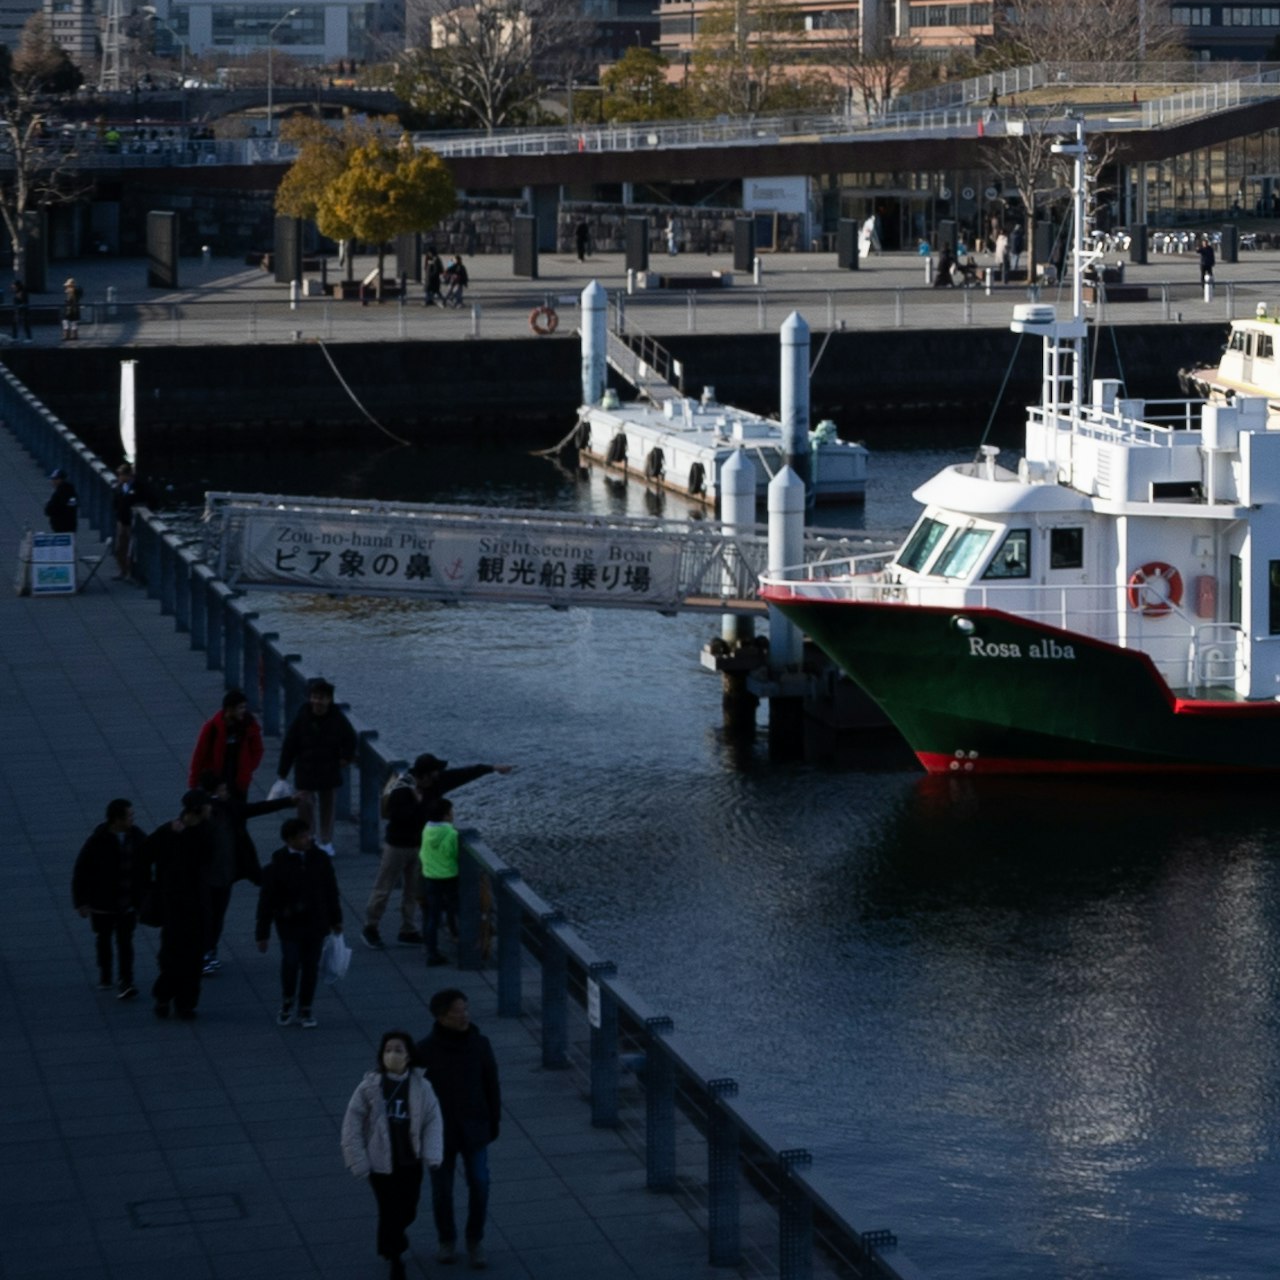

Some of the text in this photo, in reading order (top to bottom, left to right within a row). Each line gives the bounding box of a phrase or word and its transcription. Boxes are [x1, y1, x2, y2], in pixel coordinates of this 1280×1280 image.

[277, 526, 435, 551] Zou-no-hana Pier
[478, 537, 652, 563] Sightseeing Boat
[275, 545, 432, 581] ピア象の鼻
[477, 555, 651, 593] 観光船乗り場
[968, 636, 1076, 660] Rosa alba
